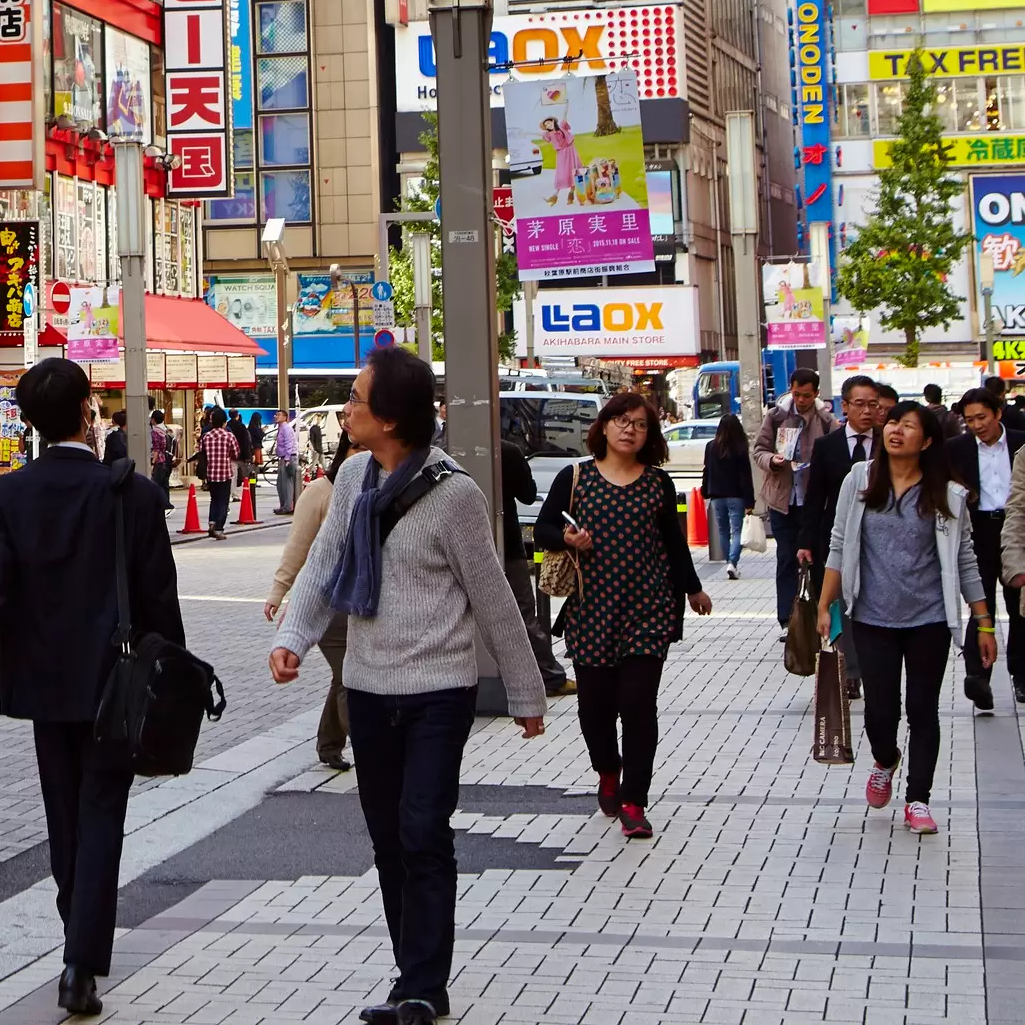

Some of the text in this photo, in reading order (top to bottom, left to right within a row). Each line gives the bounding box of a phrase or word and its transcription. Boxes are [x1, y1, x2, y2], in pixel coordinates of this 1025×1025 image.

[797, 2, 825, 125] ONODEN
[958, 46, 1025, 73] FRE
[526, 212, 640, 240] 茅原実里
[528, 244, 540, 252] NEW
[541, 242, 559, 251] SINGLE
[626, 237, 641, 245] SALE
[224, 283, 276, 292] WATCH SQUA
[542, 335, 666, 346] AKIHABARA MAIN STORE
[625, 359, 645, 367] FREE
[645, 358, 669, 366] STORE
[818, 716, 826, 745] CAMERA
